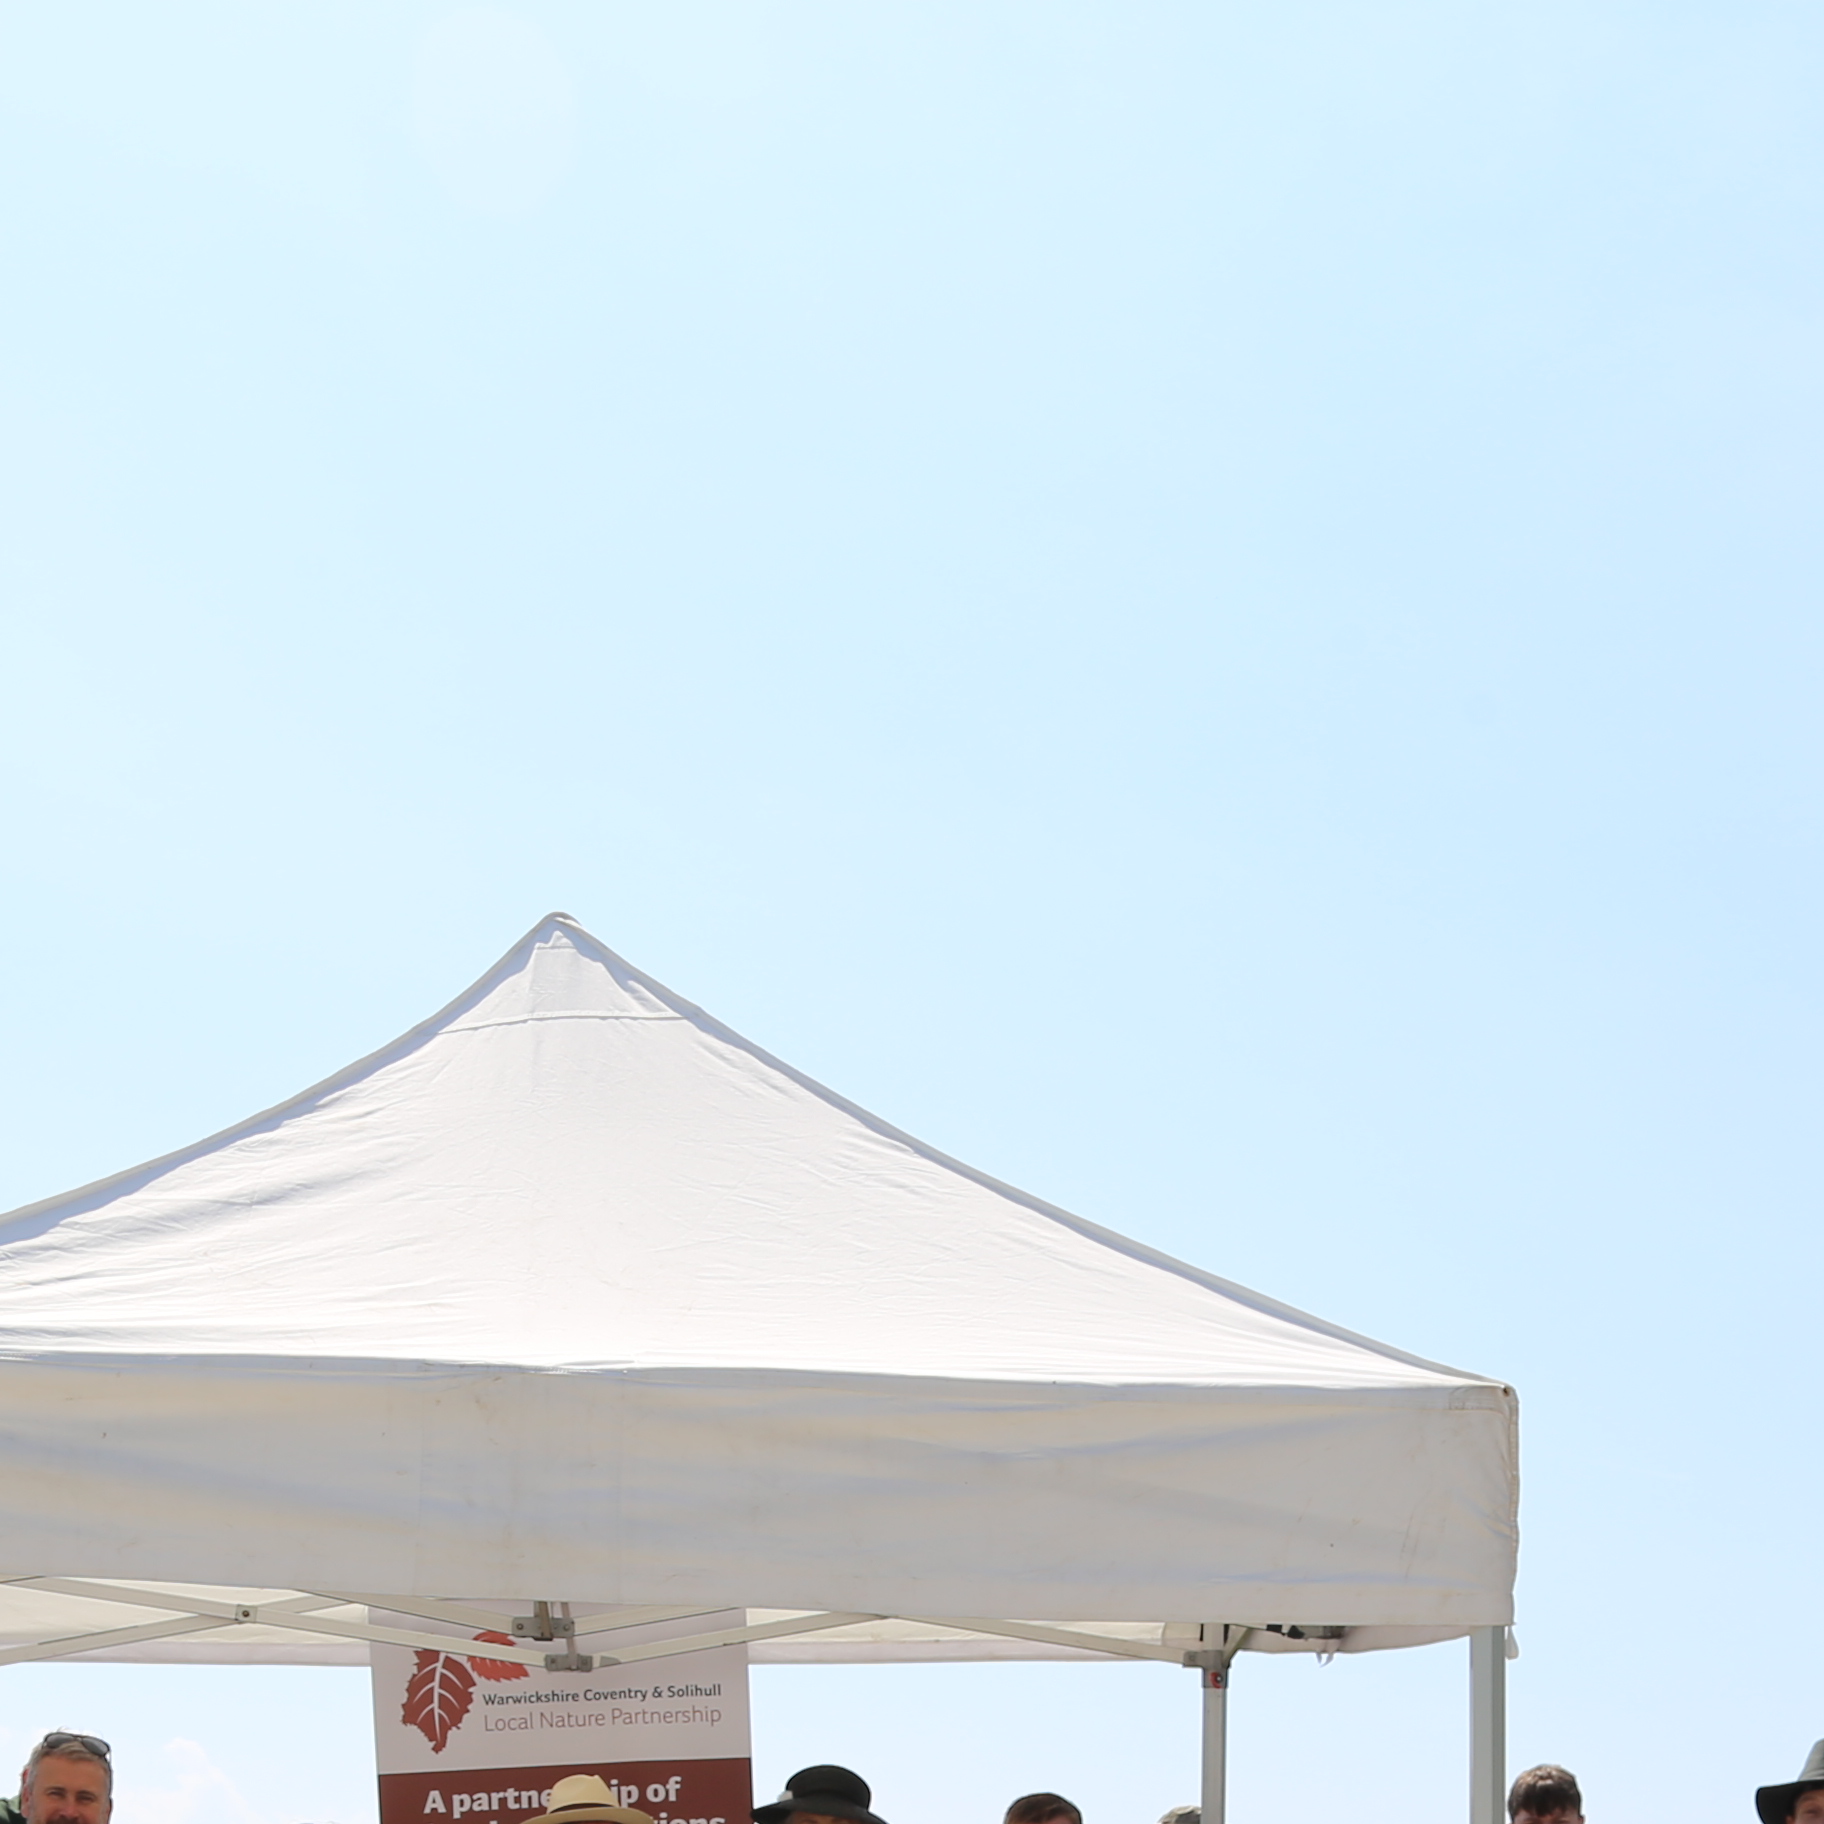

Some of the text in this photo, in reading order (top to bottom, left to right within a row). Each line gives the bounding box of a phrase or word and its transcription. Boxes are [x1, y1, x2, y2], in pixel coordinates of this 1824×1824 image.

[482, 1684, 721, 1706] Warwickshire Coventry & Solihull
[484, 1705, 721, 1732] Local Nature Partnership
[423, 1790, 447, 1814] A
[646, 1776, 682, 1803] of
